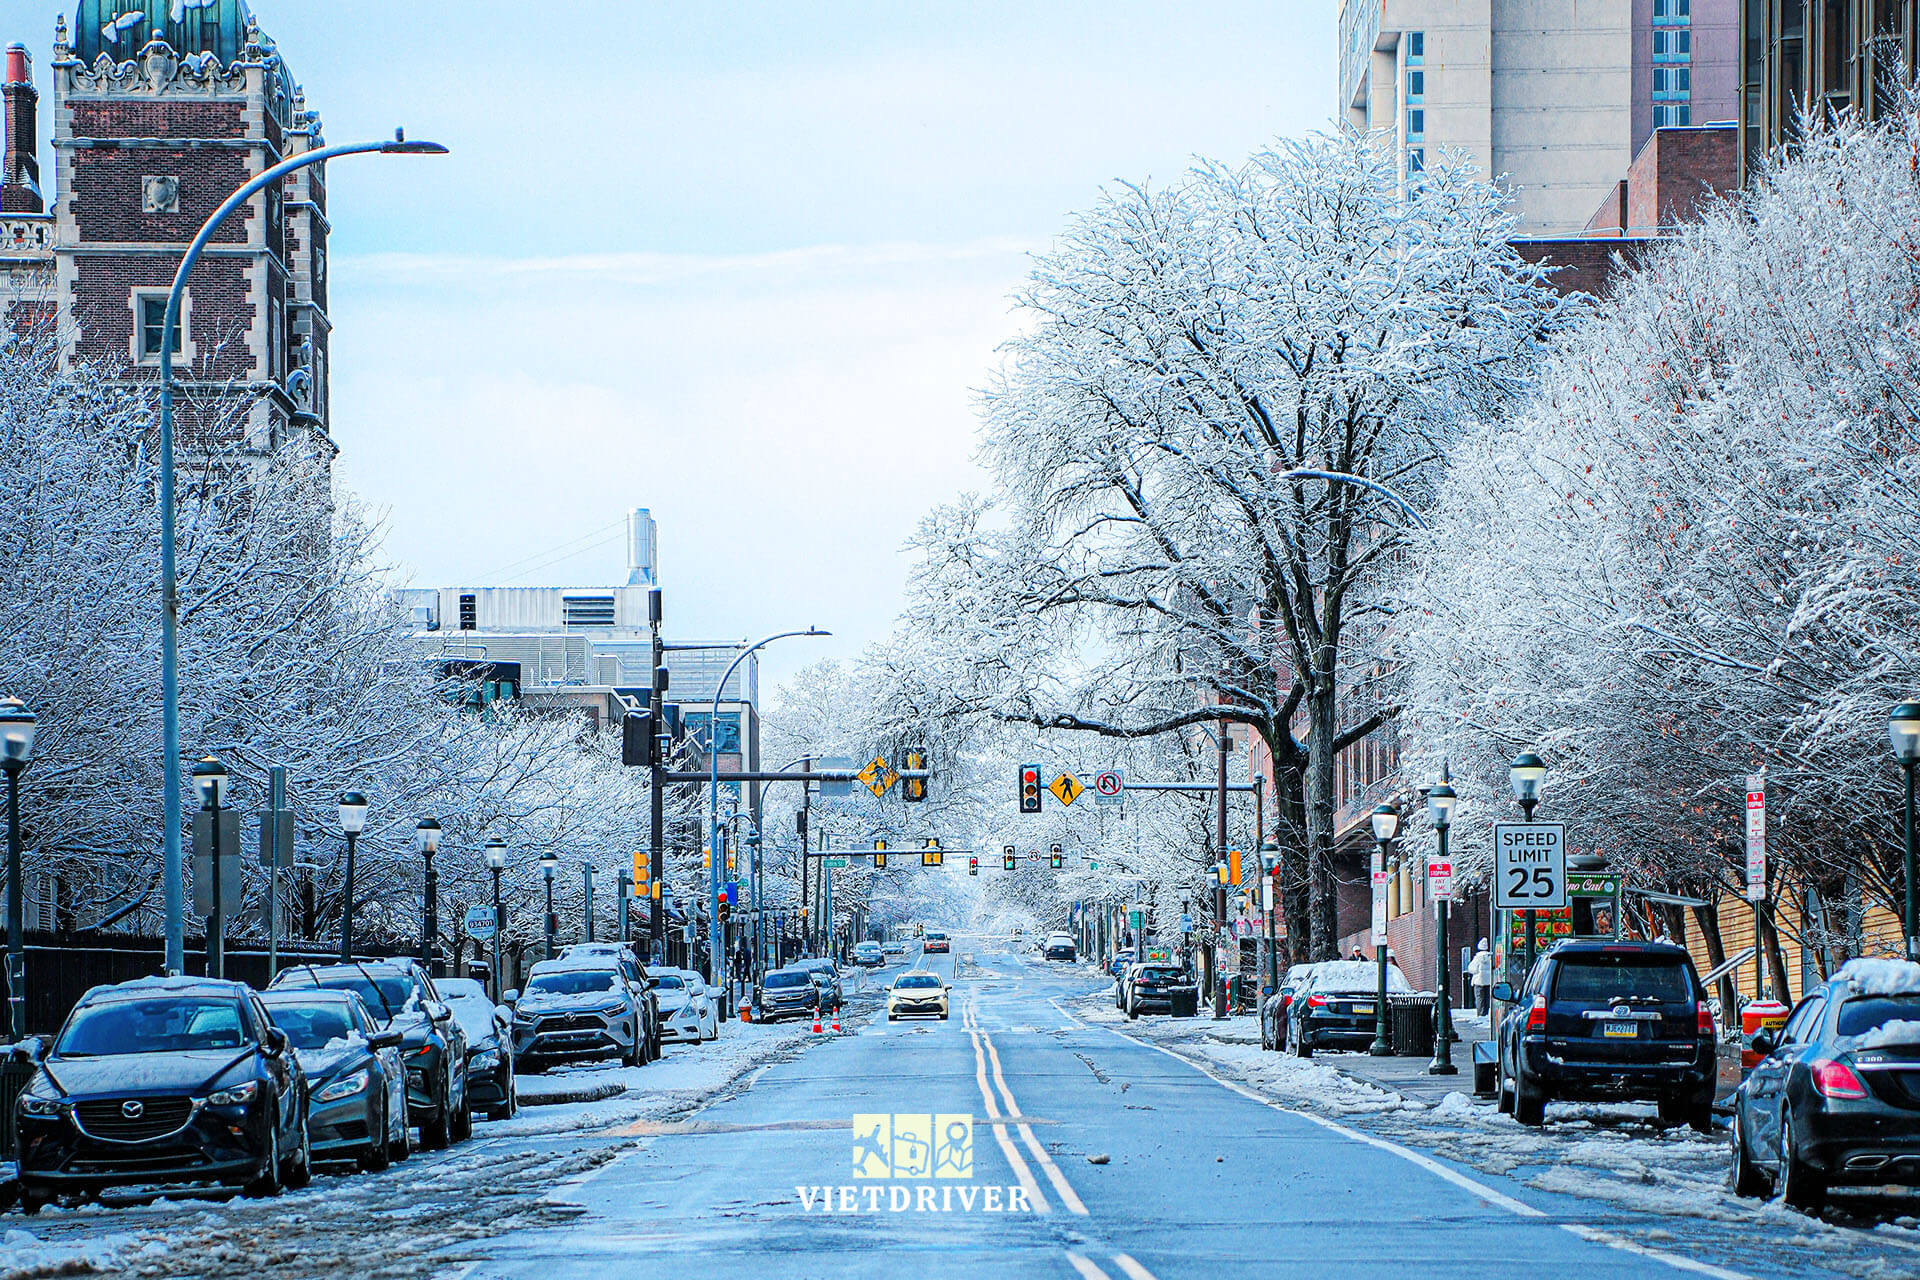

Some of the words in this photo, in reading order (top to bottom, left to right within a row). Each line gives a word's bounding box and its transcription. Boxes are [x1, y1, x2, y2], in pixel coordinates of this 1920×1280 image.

[1503, 832, 1557, 846] SPEED
[1508, 849, 1552, 862] LIMIT
[1507, 867, 1555, 898] 25
